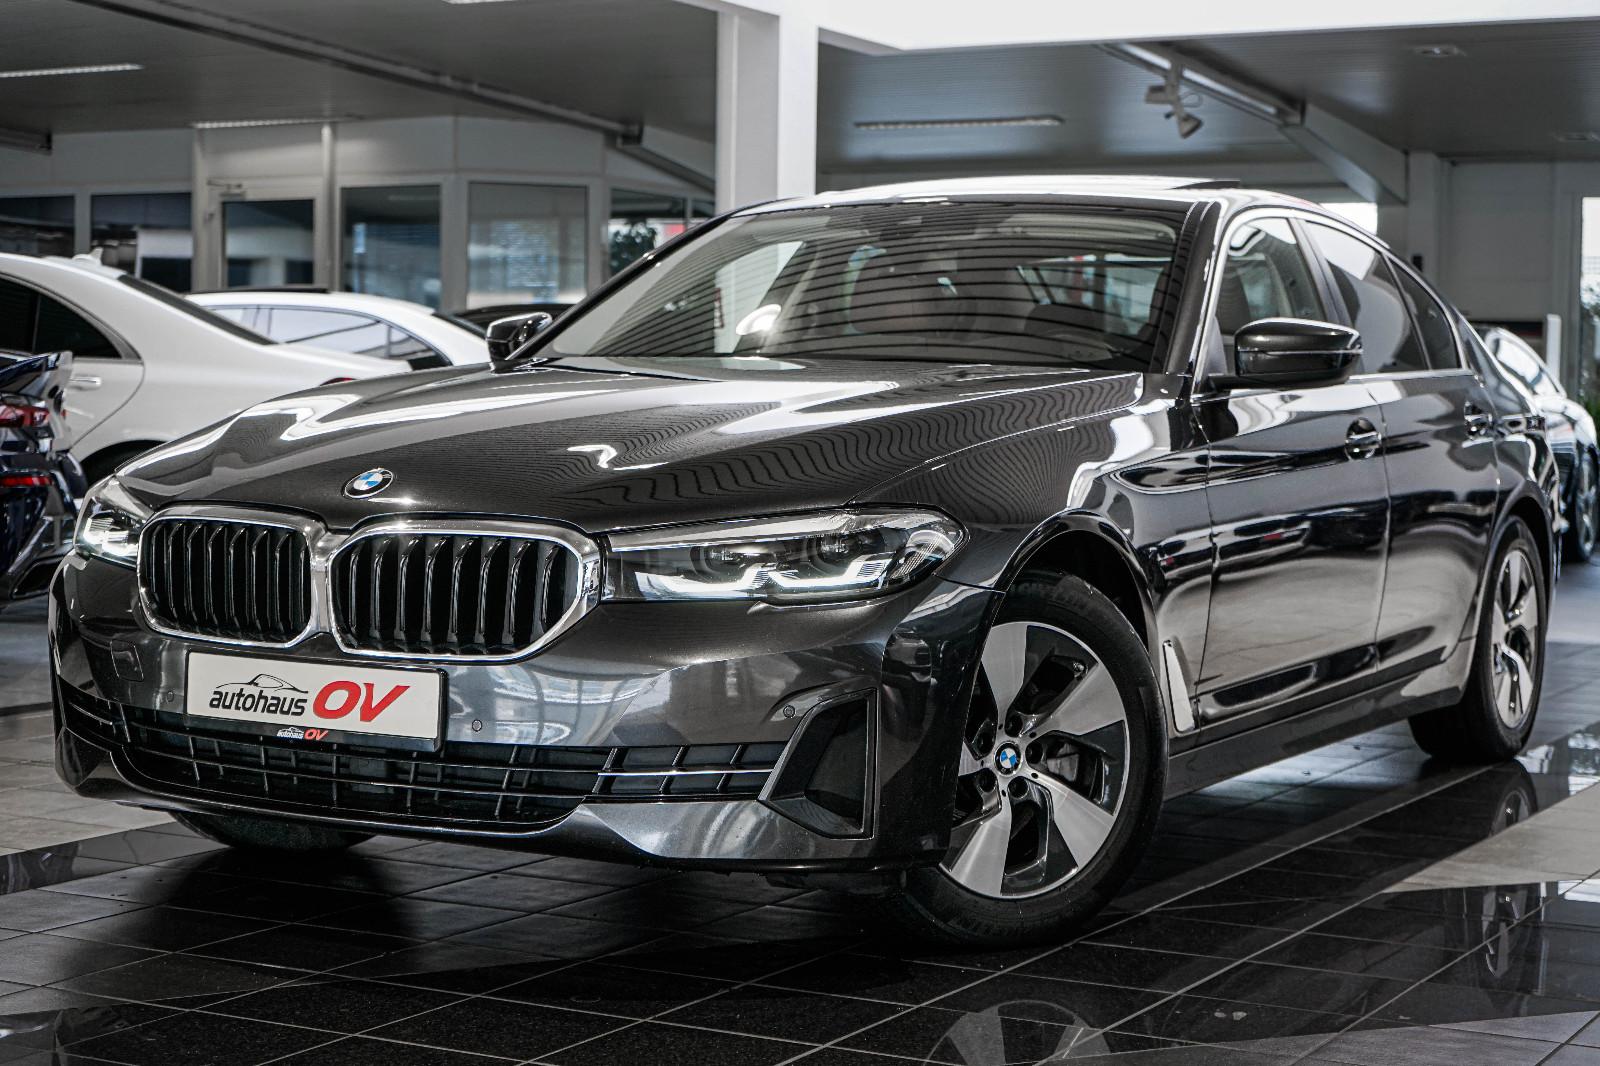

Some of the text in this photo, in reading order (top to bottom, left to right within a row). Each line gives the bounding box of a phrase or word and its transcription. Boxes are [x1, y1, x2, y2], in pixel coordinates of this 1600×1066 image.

[209, 680, 411, 723] autohaus OV
[276, 728, 329, 741] autohaus OV
